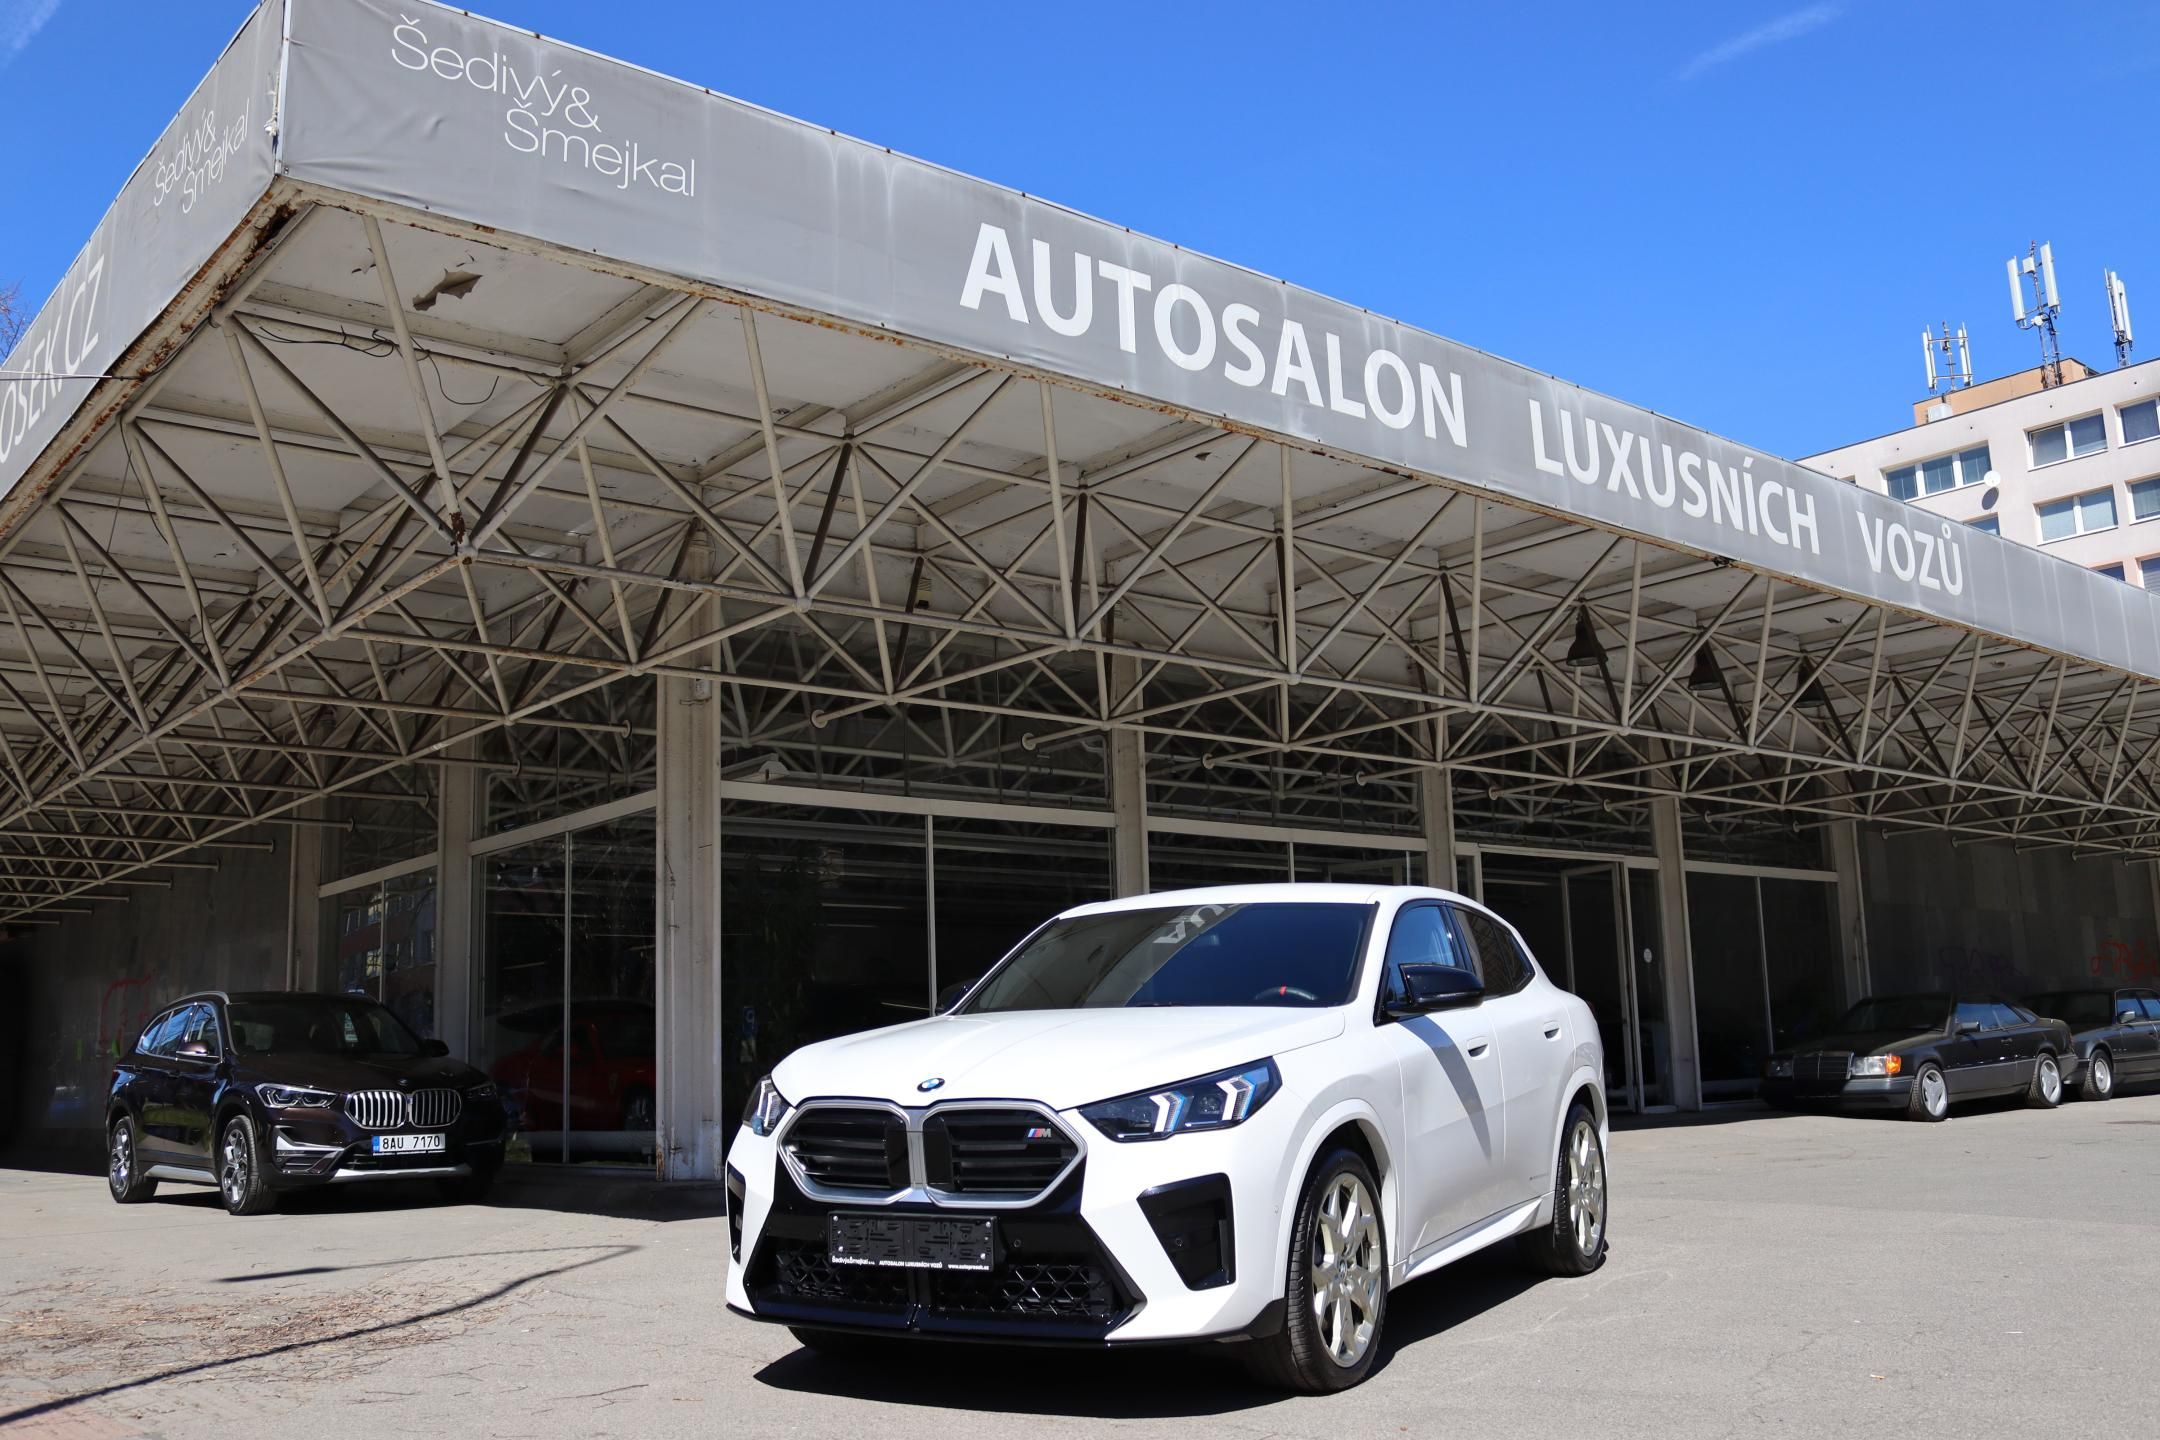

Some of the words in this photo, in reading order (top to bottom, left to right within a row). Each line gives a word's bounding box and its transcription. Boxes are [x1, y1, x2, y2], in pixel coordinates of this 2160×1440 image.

[391, 13, 602, 132] Šedivý&
[504, 97, 695, 197] Šmejkal
[959, 222, 1468, 448] AUTOSALON
[1529, 399, 1821, 556] LUXUSNÍCH
[1856, 511, 1964, 596] VOZŮ
[382, 1137, 404, 1150] 8AU
[412, 1135, 441, 1149] 7170
